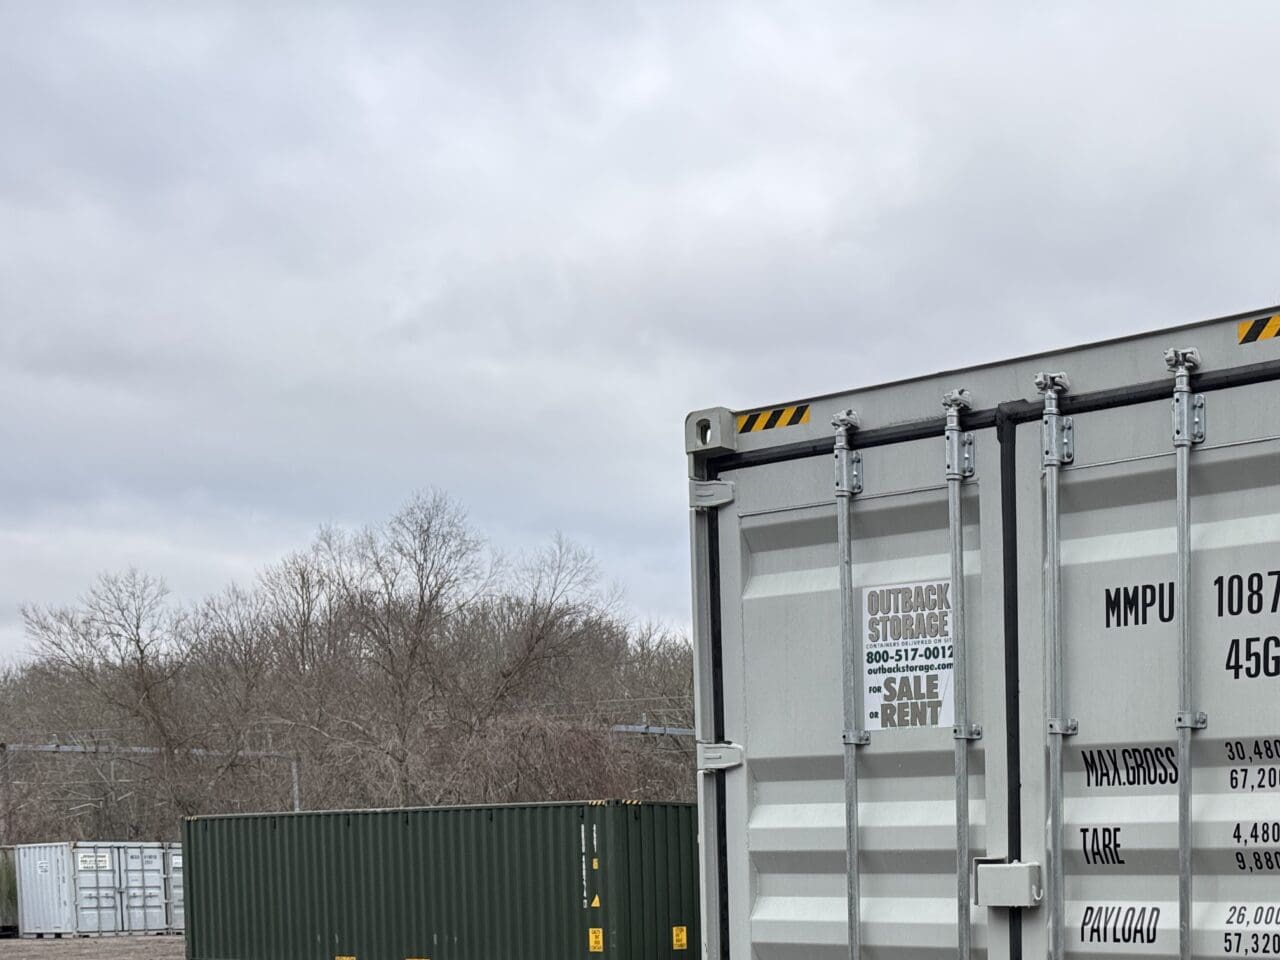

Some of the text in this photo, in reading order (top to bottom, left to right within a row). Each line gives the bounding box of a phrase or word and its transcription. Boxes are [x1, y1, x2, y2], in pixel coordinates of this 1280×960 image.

[867, 583, 951, 616] OUTBACK
[1105, 582, 1175, 628] MMPU
[868, 611, 949, 642] STORAGE
[866, 645, 953, 664] 800-517-0012
[902, 639, 932, 647] DELIVERED
[867, 662, 953, 675] outbackstorage.com
[869, 674, 939, 702] FOR SALE
[869, 700, 942, 728] OR RENT
[1081, 747, 1178, 787] MAX.GROSS
[1080, 827, 1125, 865] TARE
[1232, 822, 1280, 846] 4,480
[1080, 906, 1160, 943] PAYLOAD
[1223, 932, 1280, 955] 57,320
